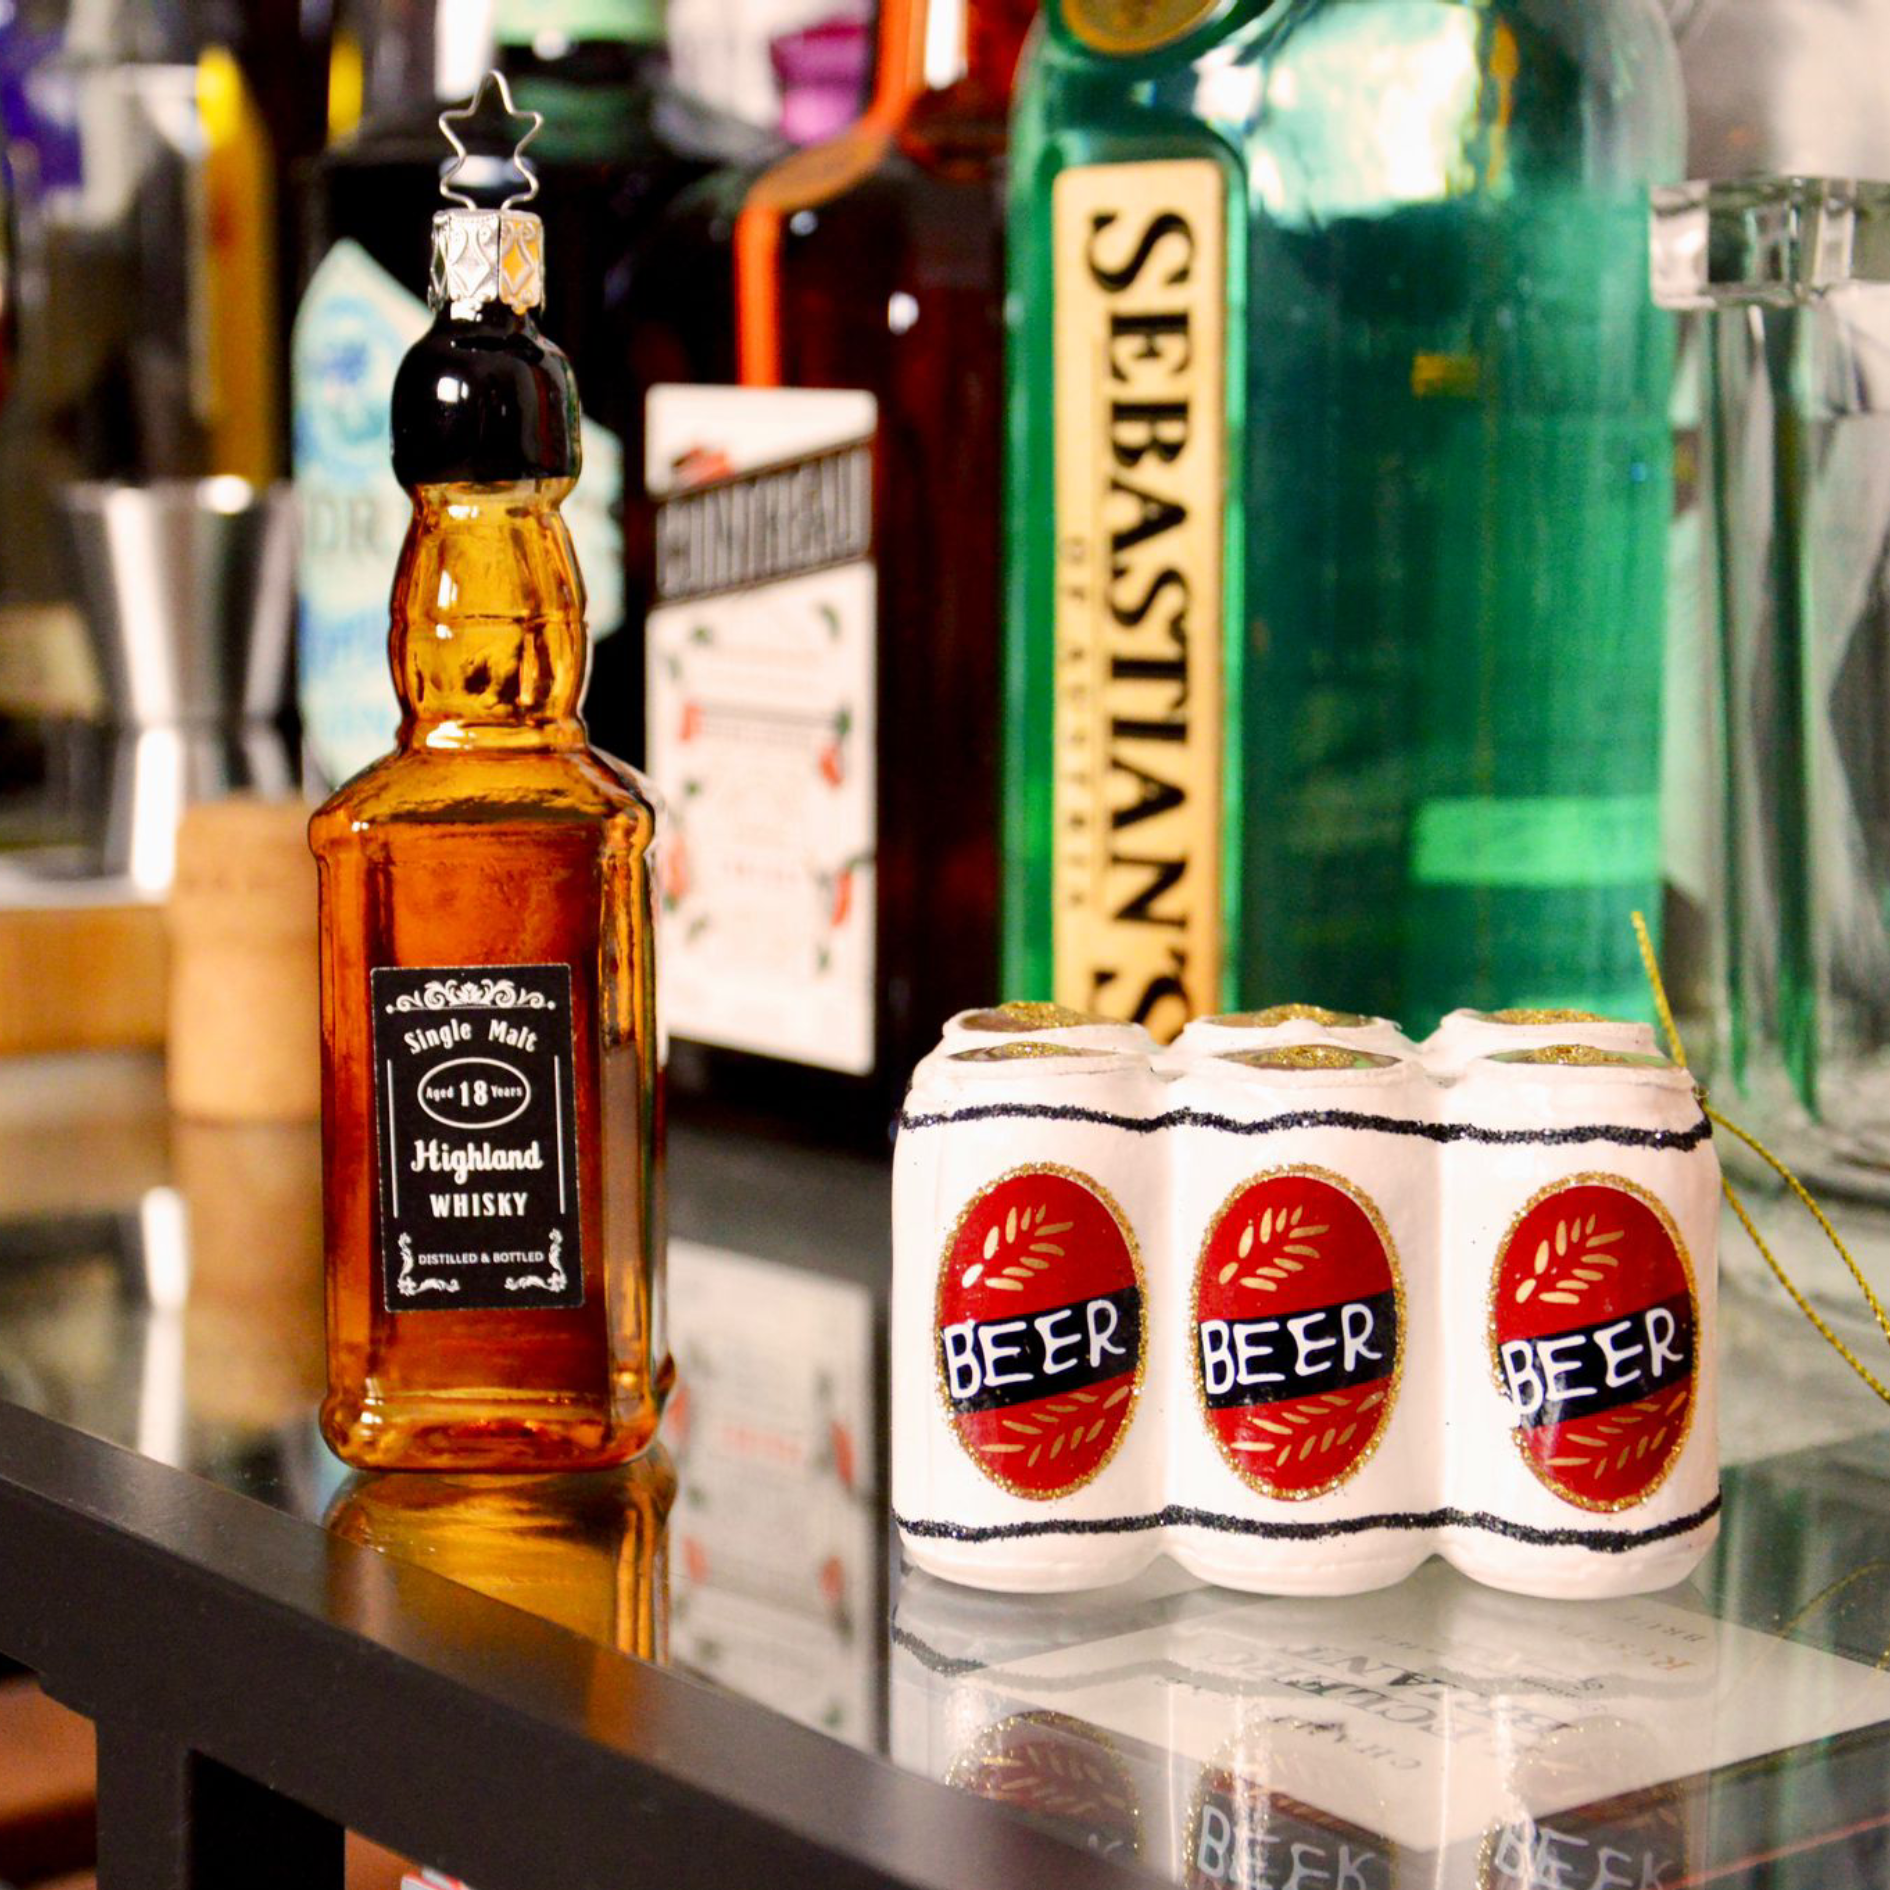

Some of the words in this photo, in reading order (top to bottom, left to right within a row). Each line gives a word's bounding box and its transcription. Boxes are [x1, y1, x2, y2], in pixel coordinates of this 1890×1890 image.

[1087, 210, 1194, 1045] SEBASTIAN'S
[403, 1018, 472, 1055] Single
[488, 1018, 538, 1053] Malt
[425, 1085, 455, 1102] Aged
[459, 1079, 488, 1107] 18
[490, 1085, 523, 1098] Years
[410, 1138, 544, 1185] Highland
[429, 1191, 528, 1218] WHISKY
[418, 1252, 478, 1265] DISTILLED
[481, 1252, 490, 1264] &
[493, 1251, 545, 1263] BOTTLED
[941, 1297, 1125, 1400] BEER
[1200, 1303, 1384, 1396] BEER
[1501, 1308, 1685, 1416] BEER
